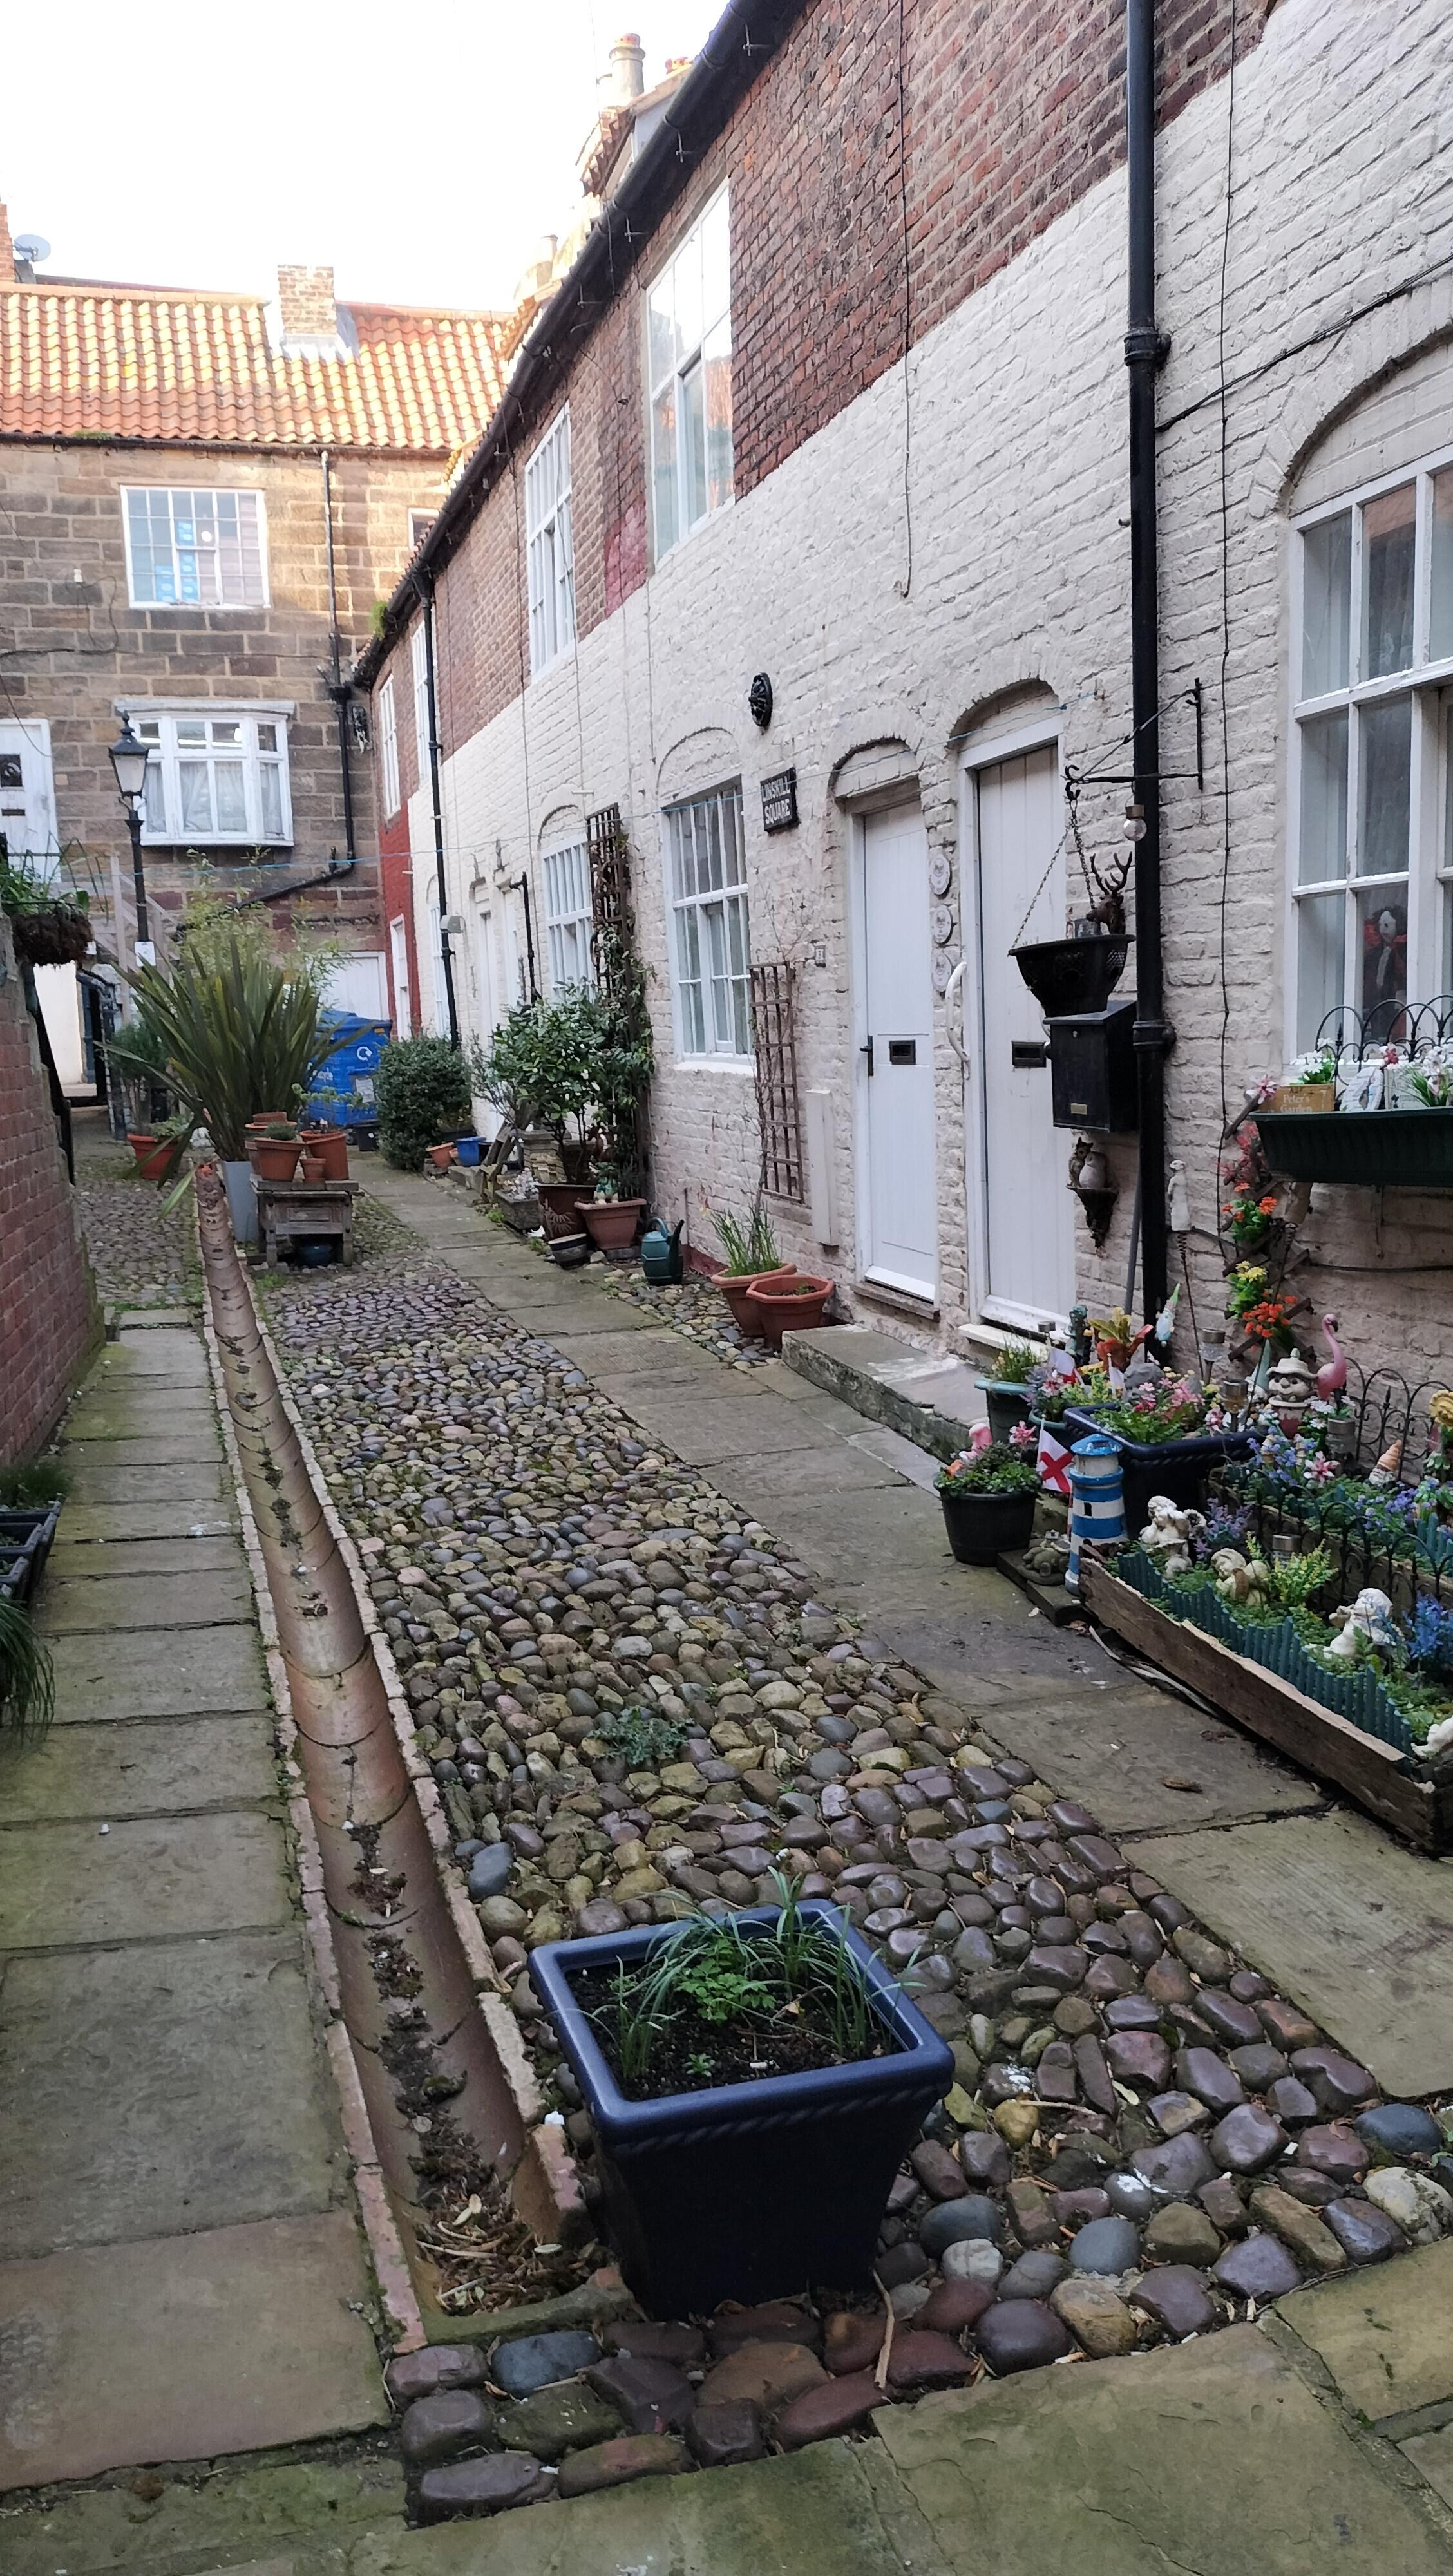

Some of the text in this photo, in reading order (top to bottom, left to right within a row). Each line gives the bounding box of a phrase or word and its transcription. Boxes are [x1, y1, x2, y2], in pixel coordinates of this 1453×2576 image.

[761, 775, 791, 802] LINSKILL
[764, 798, 790, 824] SQUARE
[1283, 1093, 1310, 1103] Peter's
[1280, 1104, 1313, 1113] Garden
